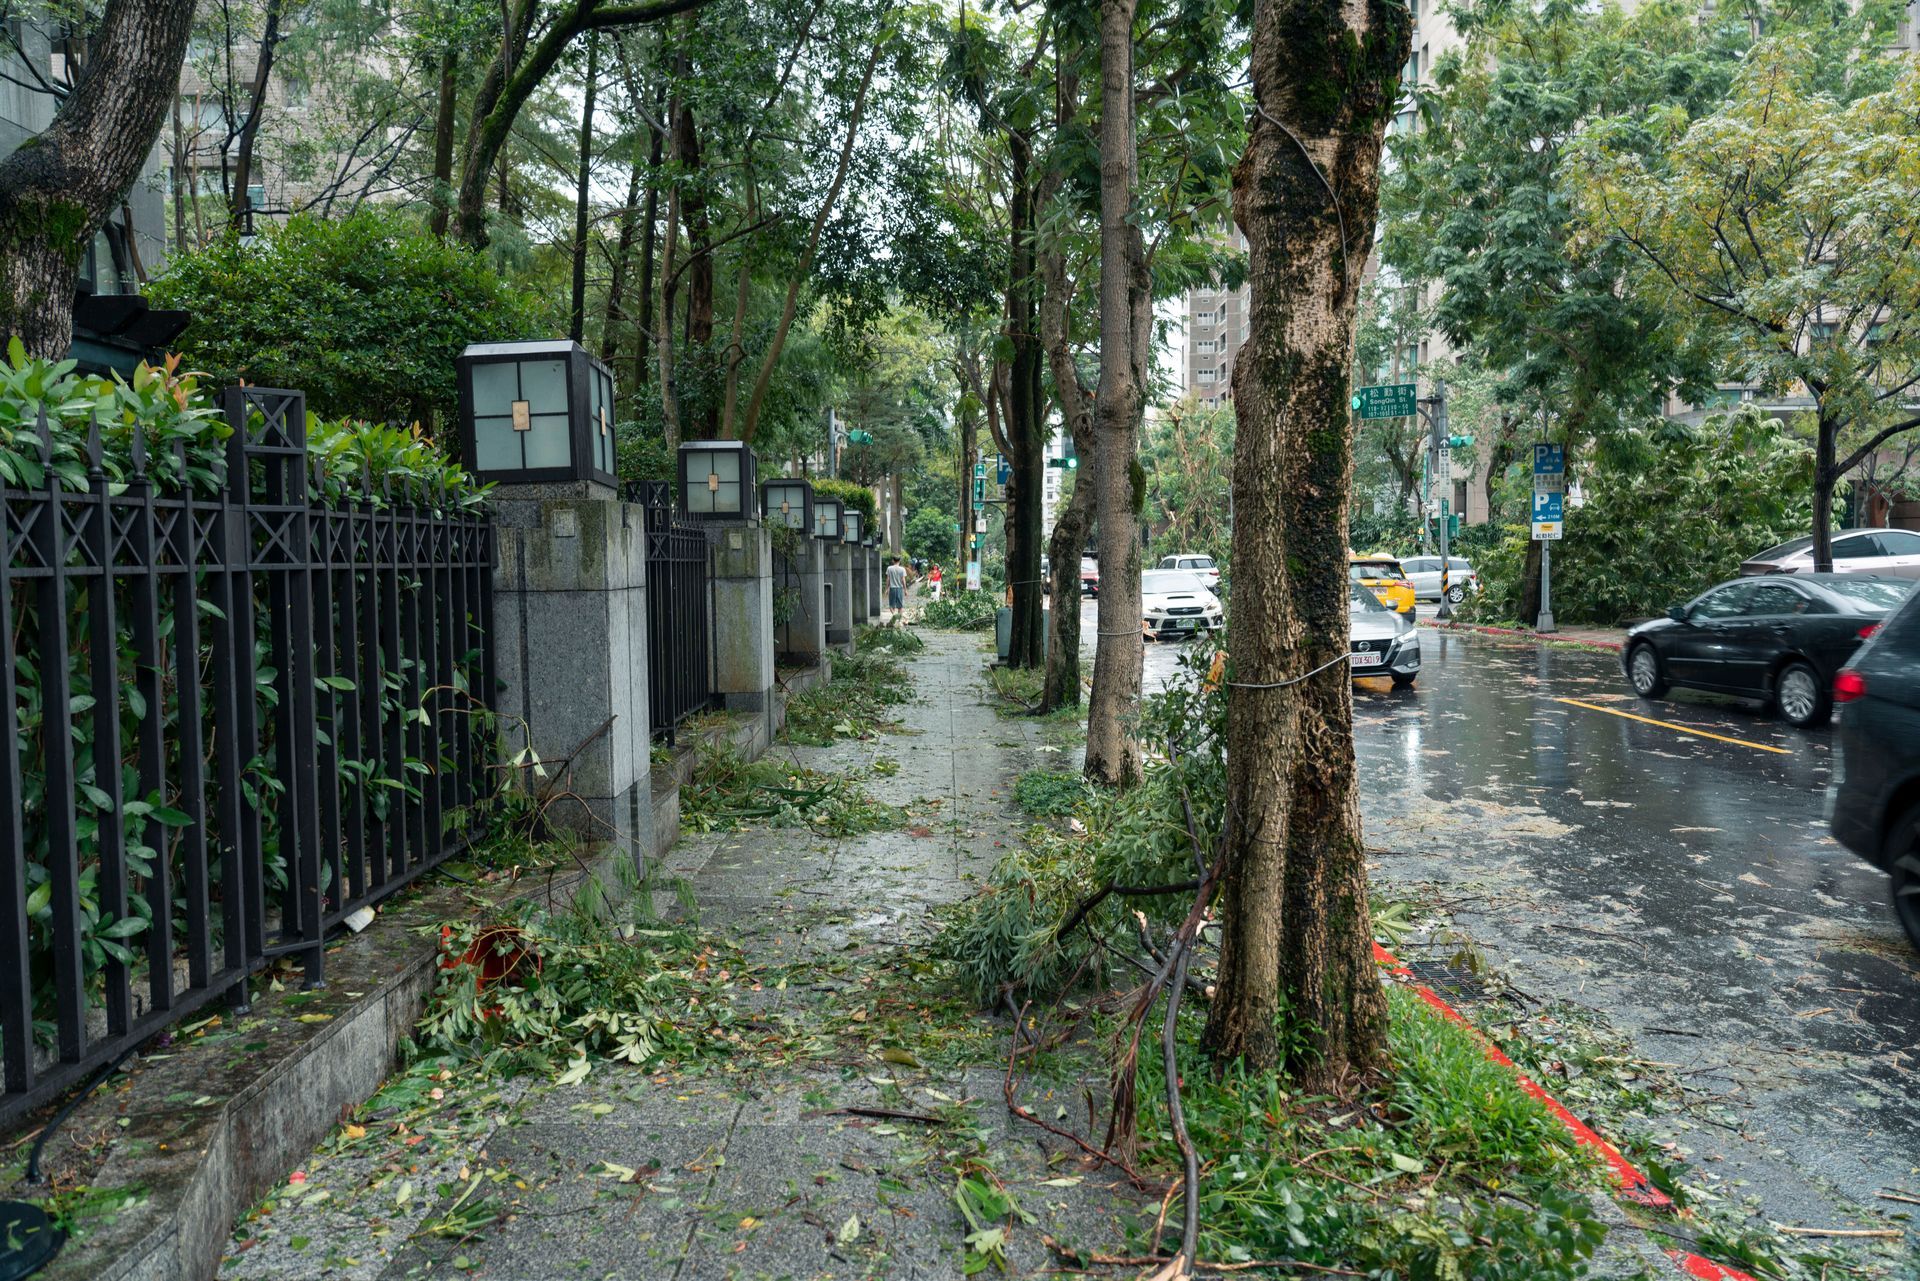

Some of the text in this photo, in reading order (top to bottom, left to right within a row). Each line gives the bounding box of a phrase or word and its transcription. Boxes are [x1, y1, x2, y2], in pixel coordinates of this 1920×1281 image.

[1370, 387, 1407, 398] 松勤街
[1535, 445, 1549, 464] P
[1534, 493, 1550, 511] P
